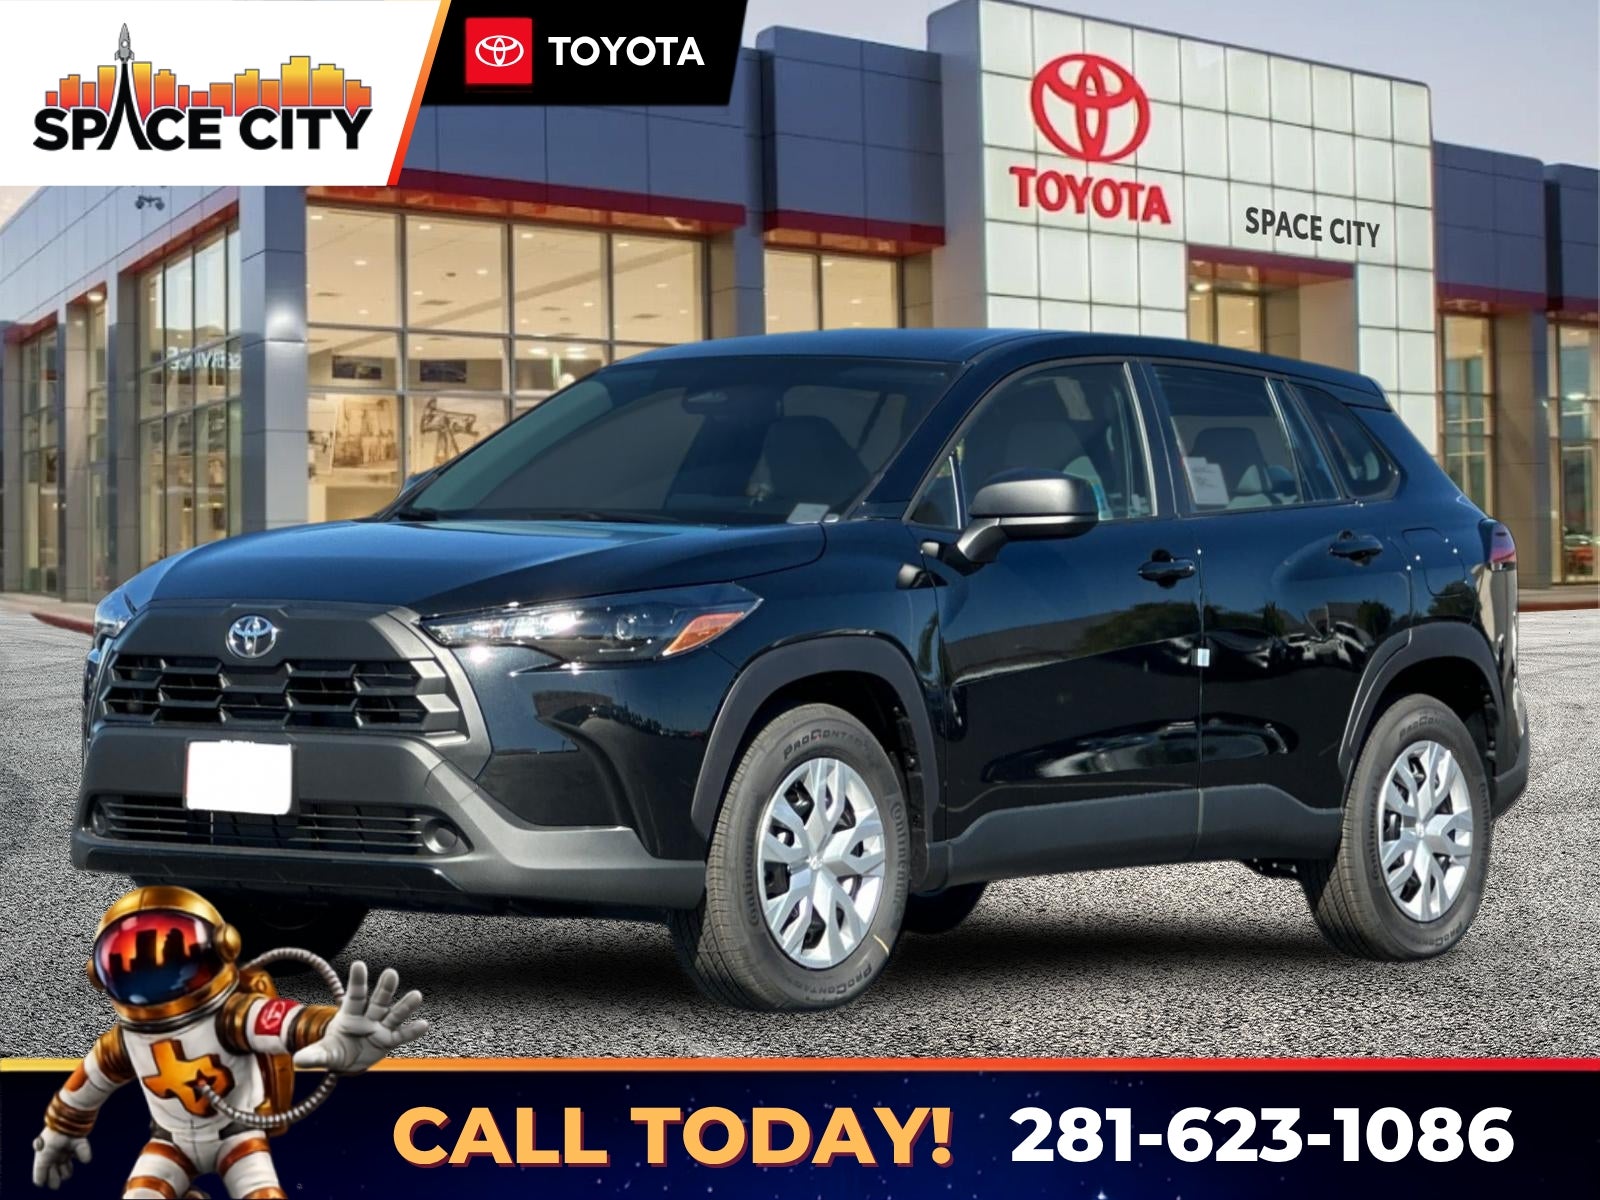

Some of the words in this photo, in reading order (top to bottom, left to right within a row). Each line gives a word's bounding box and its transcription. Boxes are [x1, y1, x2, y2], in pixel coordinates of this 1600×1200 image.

[1008, 166, 1171, 224] TOYOTA
[1245, 206, 1323, 241] SPACE
[1329, 217, 1381, 248] CITY
